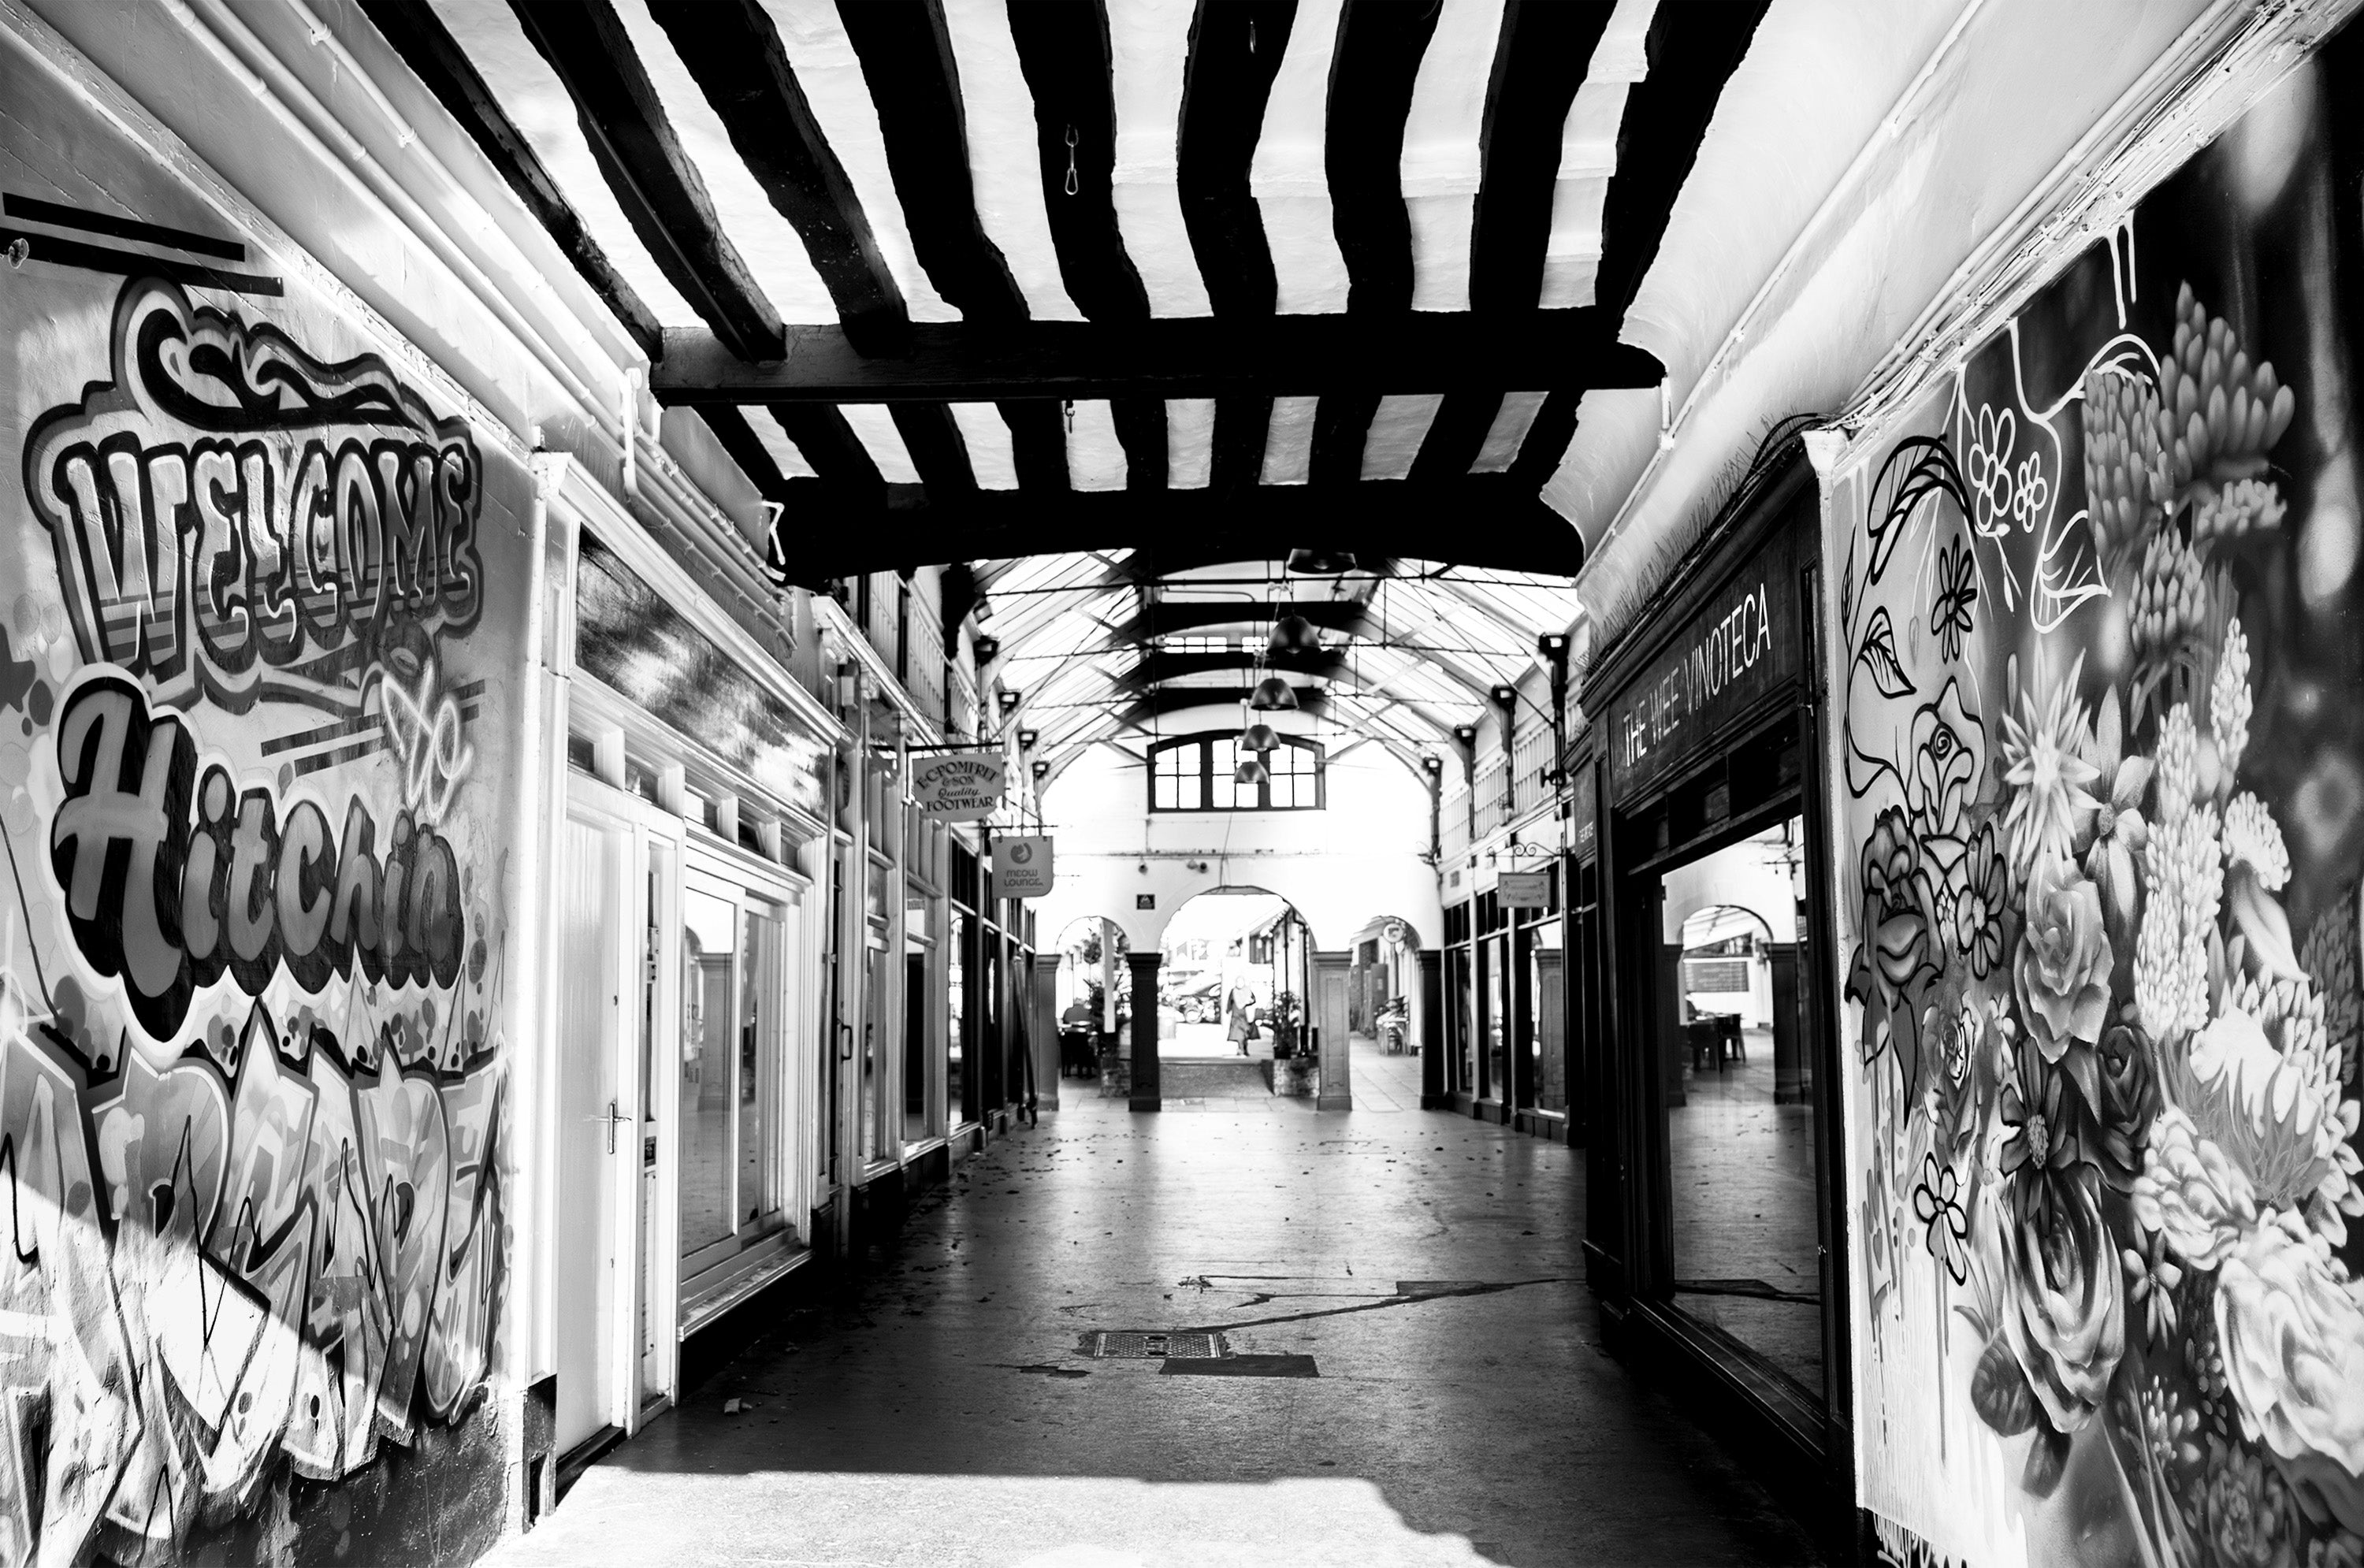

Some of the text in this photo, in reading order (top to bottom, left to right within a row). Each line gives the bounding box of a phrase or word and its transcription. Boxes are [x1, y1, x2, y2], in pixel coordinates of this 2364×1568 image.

[52, 433, 478, 684] WELCOME
[1623, 582, 1771, 767] THE WEE VINOTECA
[942, 775, 976, 786] & SON
[938, 787, 980, 800] Quality
[925, 795, 994, 812] FOOTWEAR
